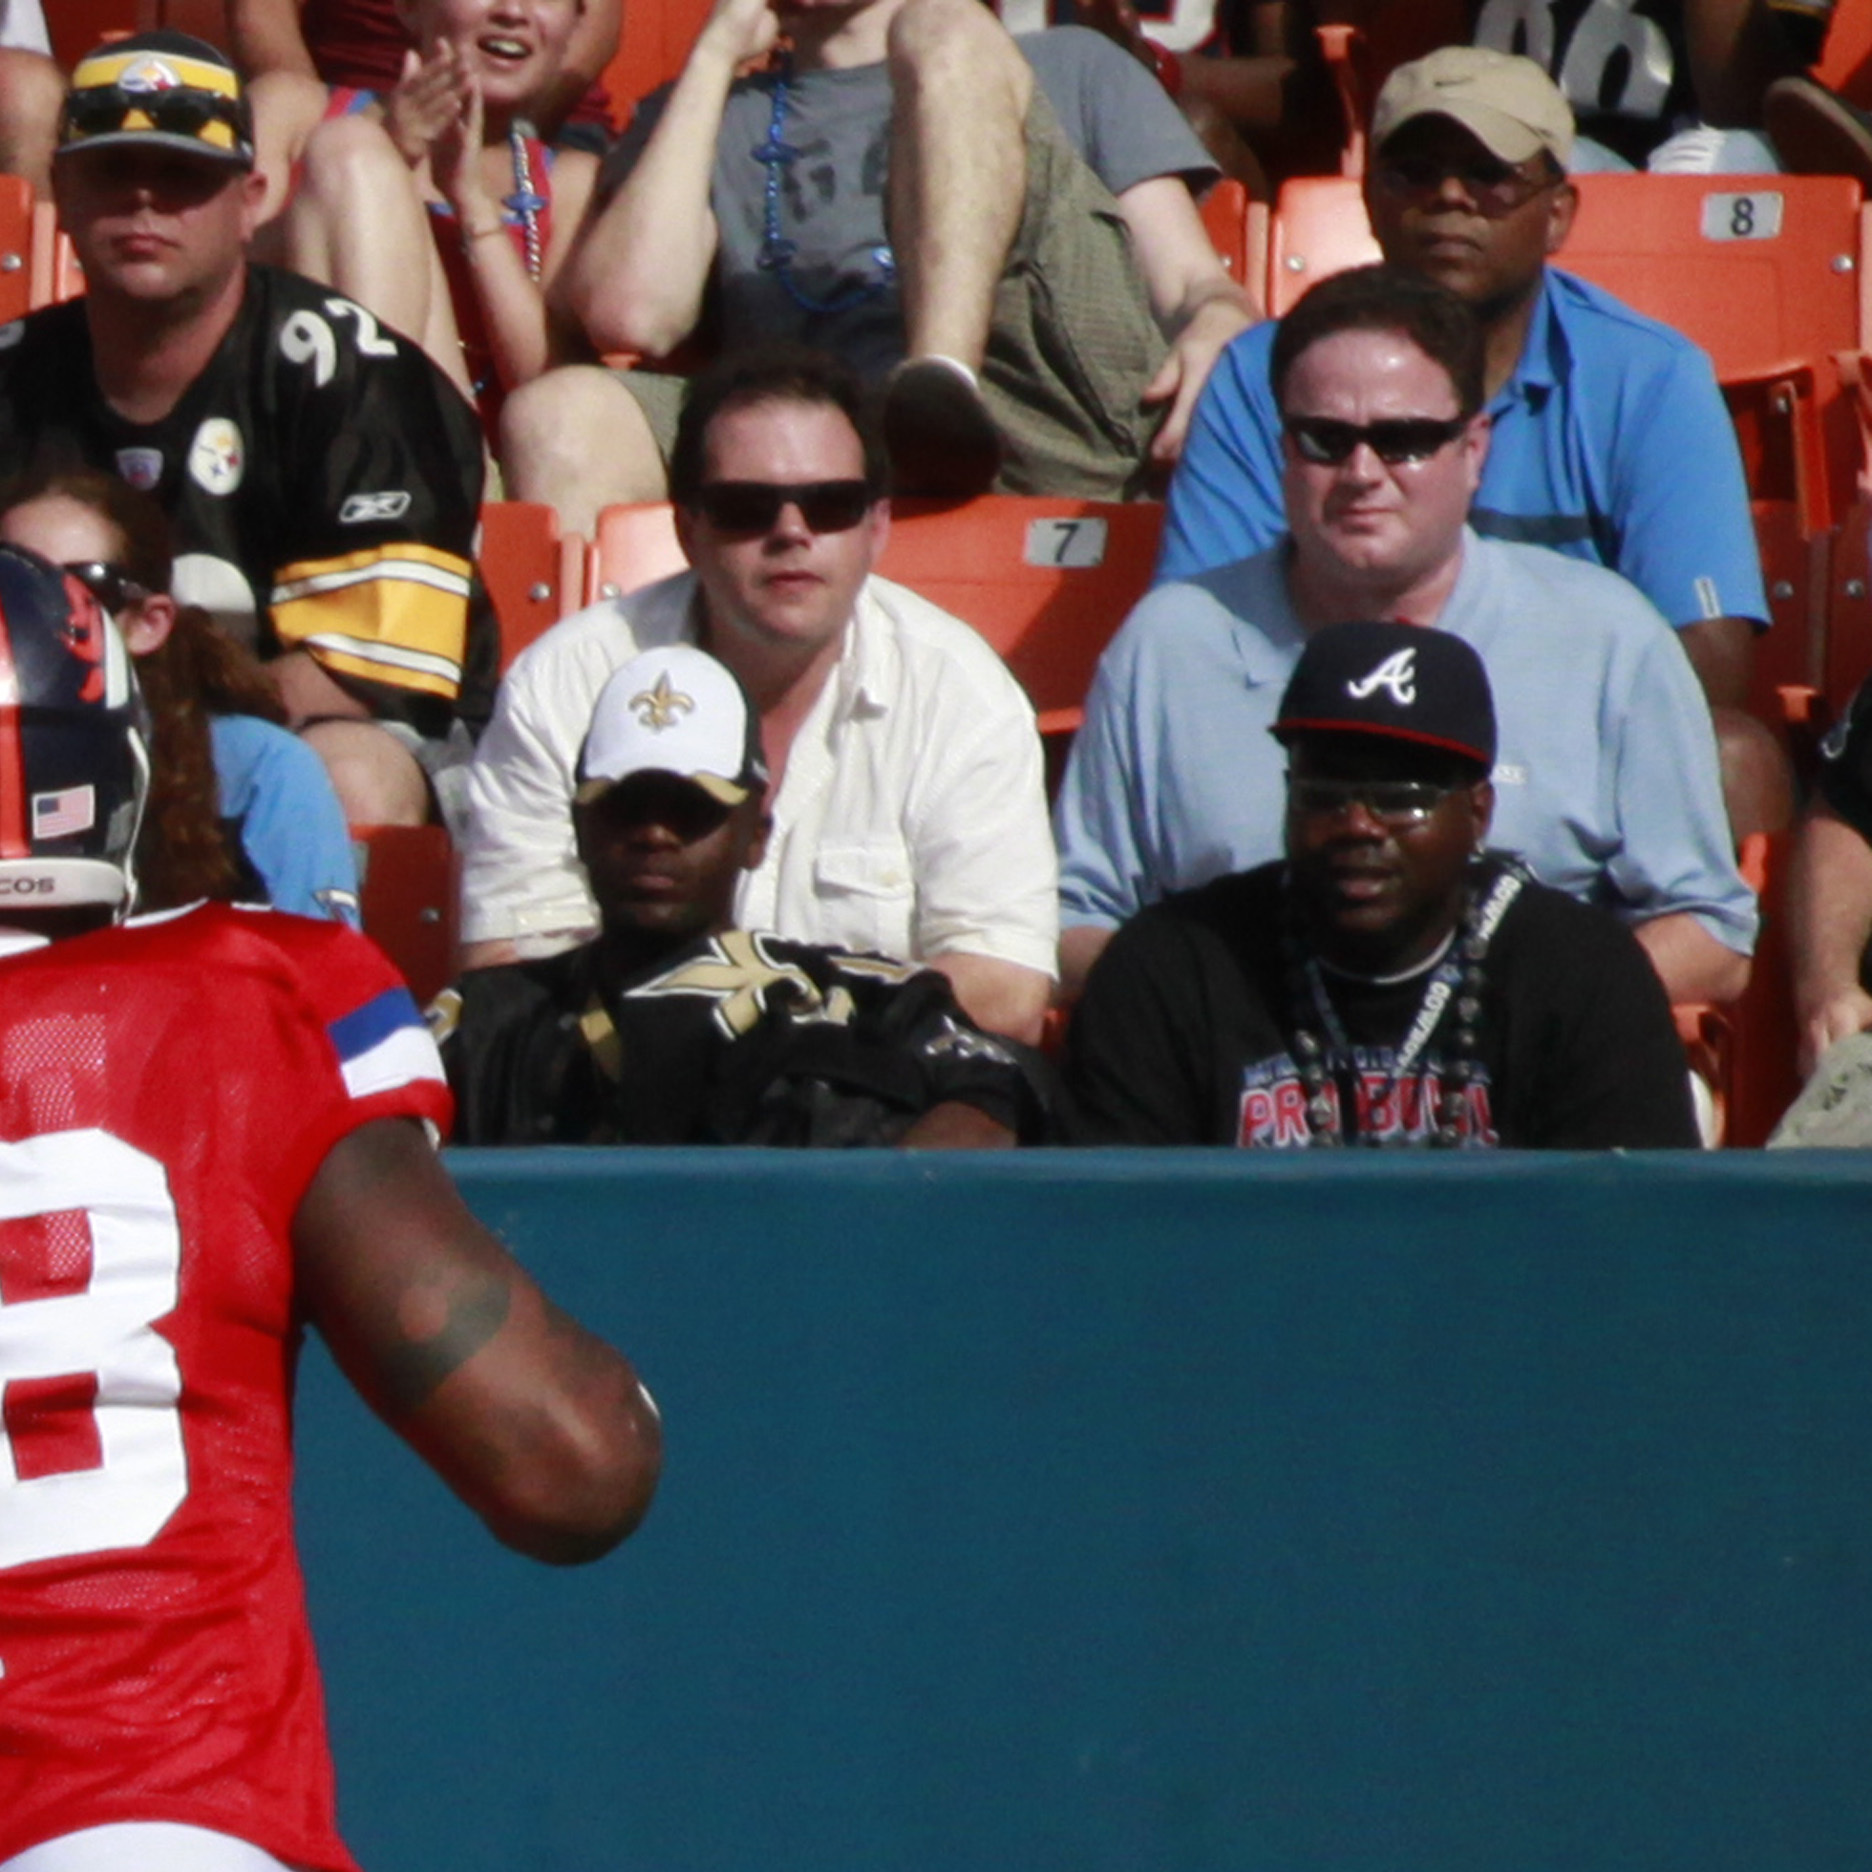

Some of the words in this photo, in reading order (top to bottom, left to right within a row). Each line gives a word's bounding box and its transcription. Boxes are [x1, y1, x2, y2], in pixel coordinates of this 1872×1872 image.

[1730, 197, 1755, 236] 8
[278, 300, 398, 388] 92
[1053, 523, 1080, 563] 7
[1346, 646, 1417, 704] A
